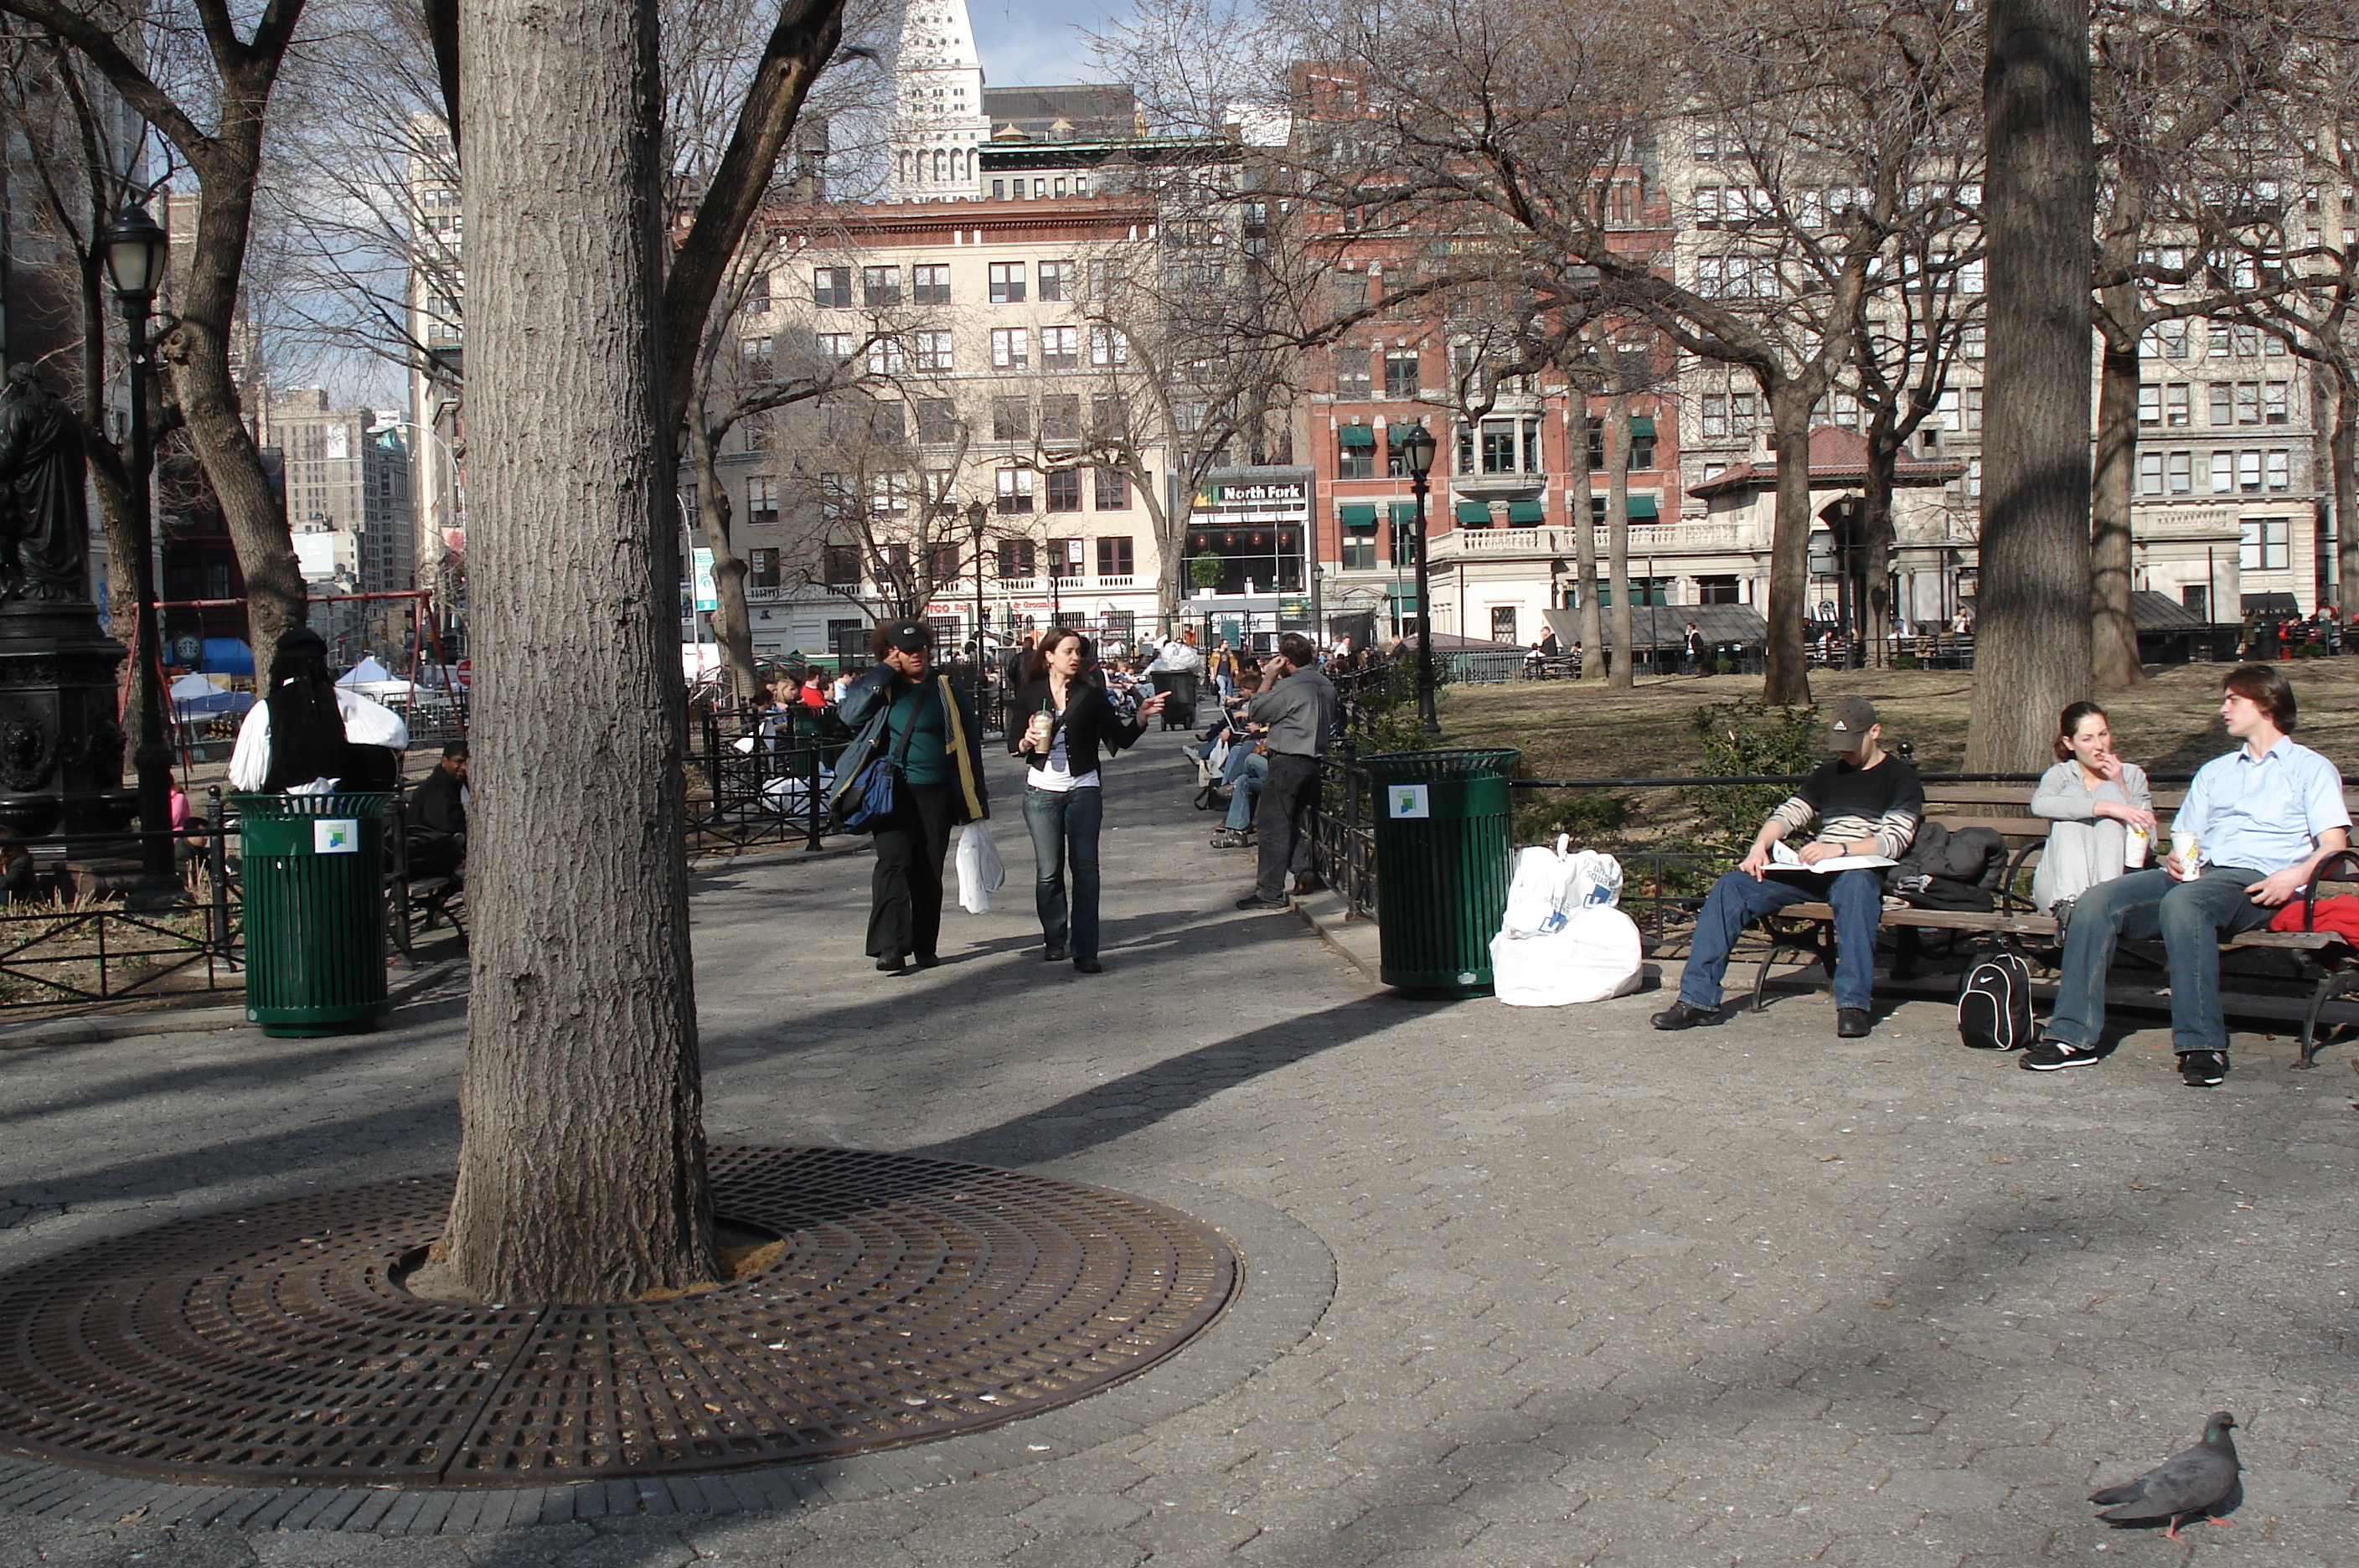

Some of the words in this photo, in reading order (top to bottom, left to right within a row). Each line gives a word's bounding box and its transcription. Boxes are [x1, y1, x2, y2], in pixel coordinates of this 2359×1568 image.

[1224, 485, 1266, 499] North
[1267, 483, 1300, 498] Fork
[928, 604, 950, 613] TCO
